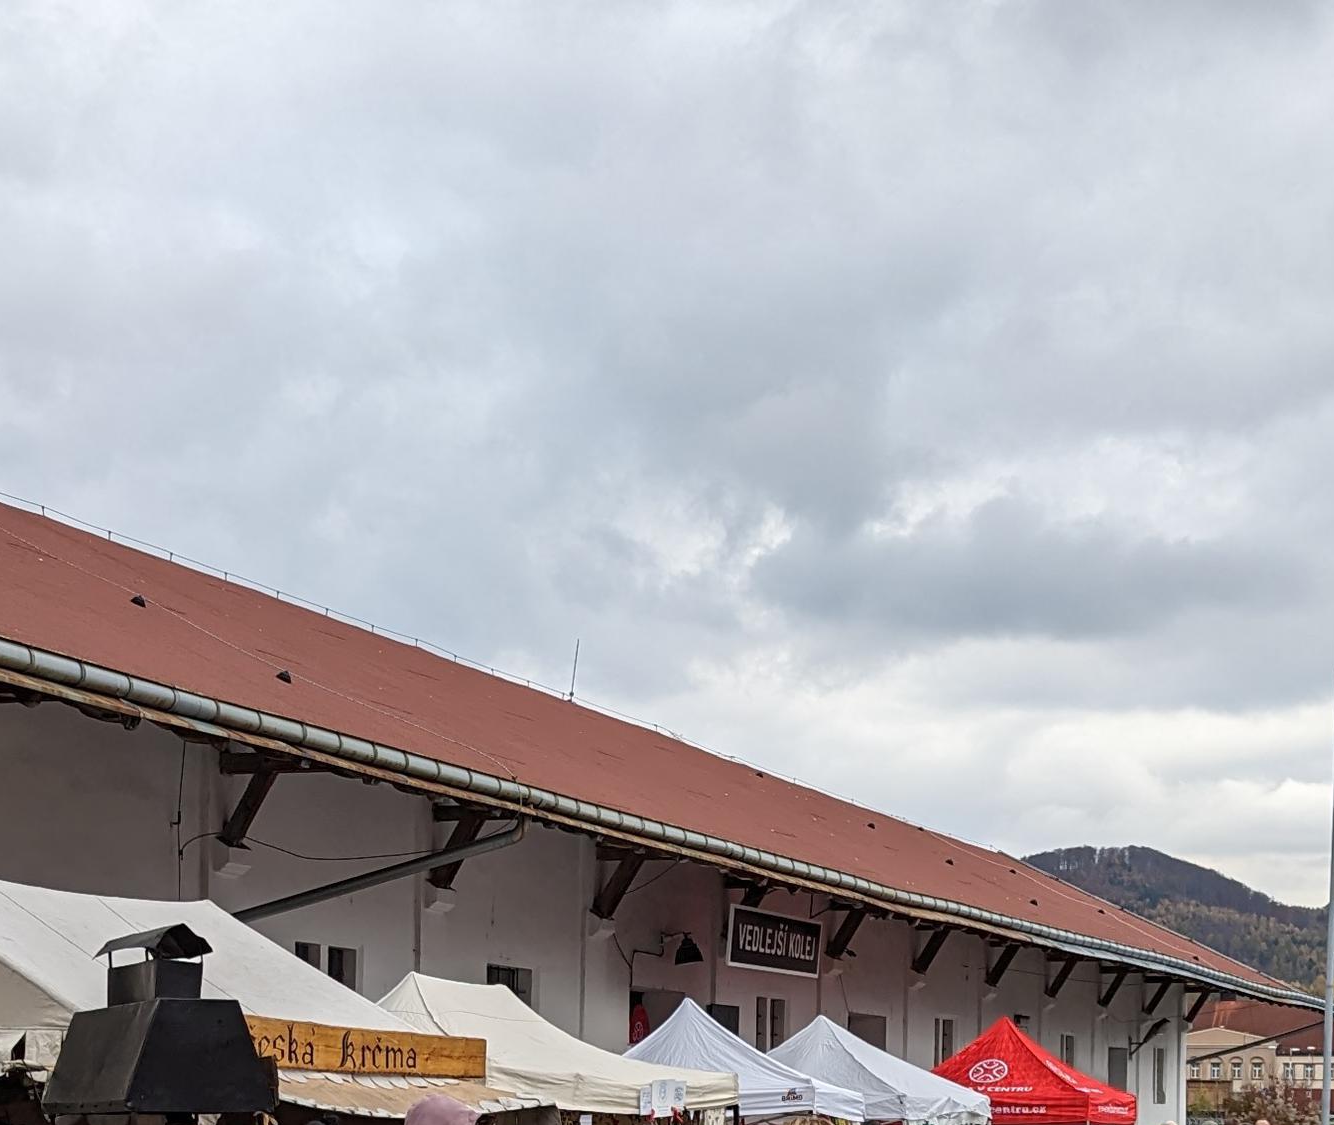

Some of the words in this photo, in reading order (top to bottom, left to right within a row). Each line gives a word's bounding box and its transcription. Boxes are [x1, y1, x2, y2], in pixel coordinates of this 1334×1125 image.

[739, 923, 788, 956] VEDLEJŠÍ
[788, 933, 815, 960] KOLEJ
[248, 1023, 315, 1066] eská
